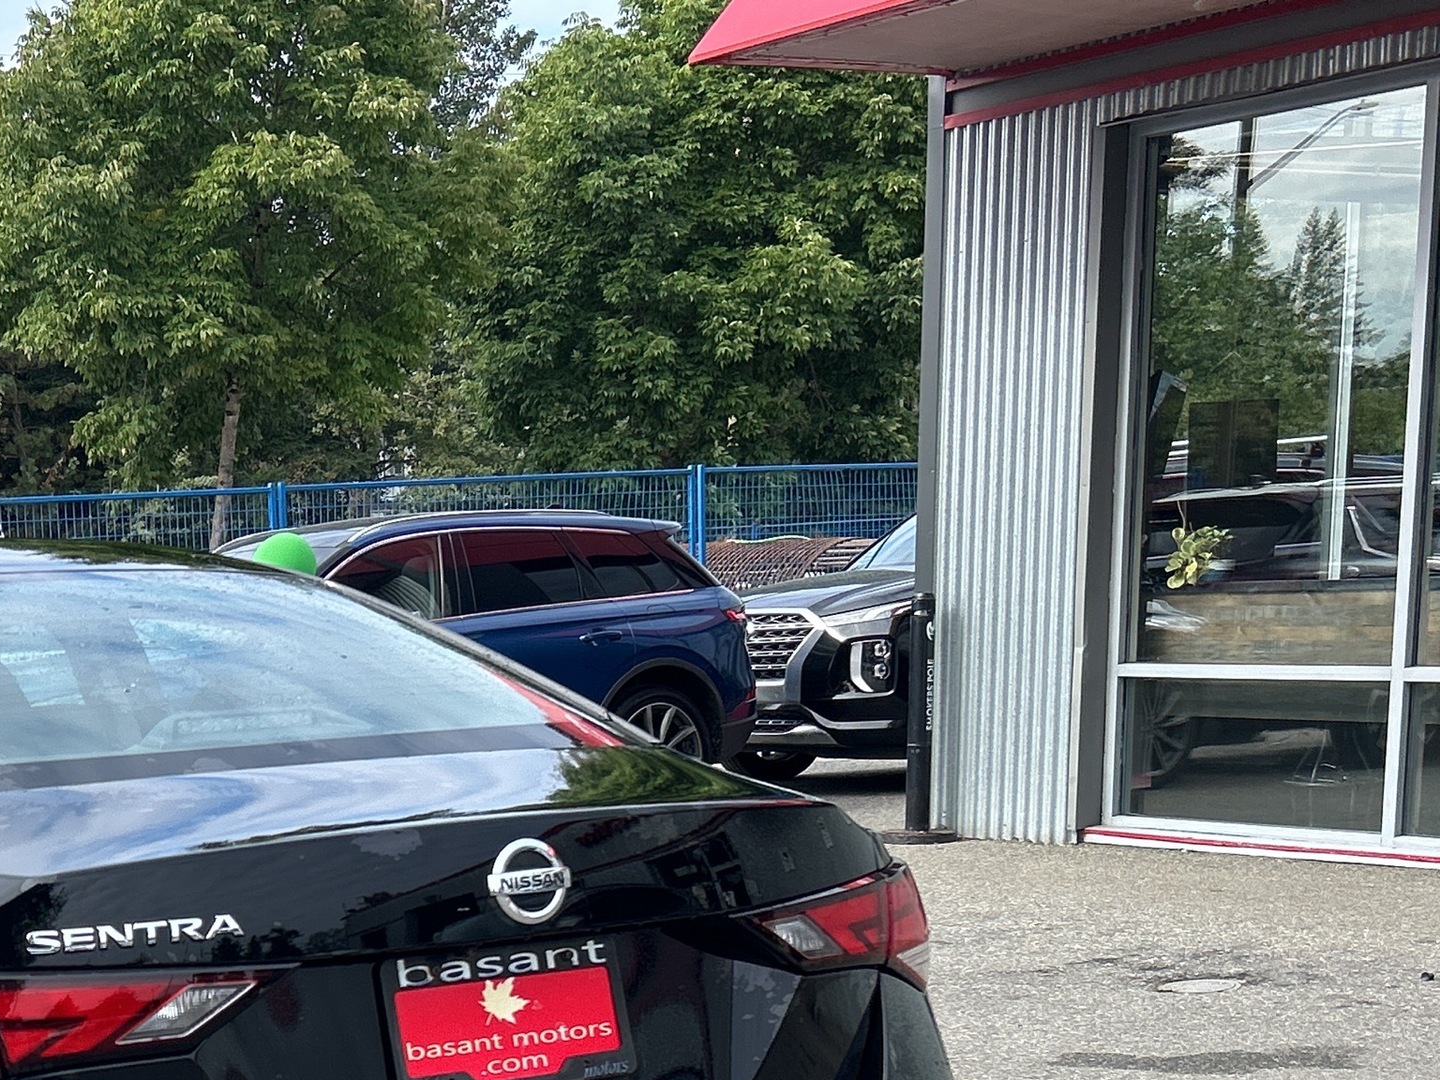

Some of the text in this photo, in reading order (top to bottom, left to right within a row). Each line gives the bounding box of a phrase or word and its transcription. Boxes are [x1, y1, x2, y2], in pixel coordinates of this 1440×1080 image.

[500, 871, 565, 891] NISSAN
[26, 914, 245, 955] SENTRA
[397, 940, 608, 988] basant
[406, 1021, 613, 1061] basant motors
[481, 1053, 550, 1076] .com
[583, 1060, 630, 1078] motors
